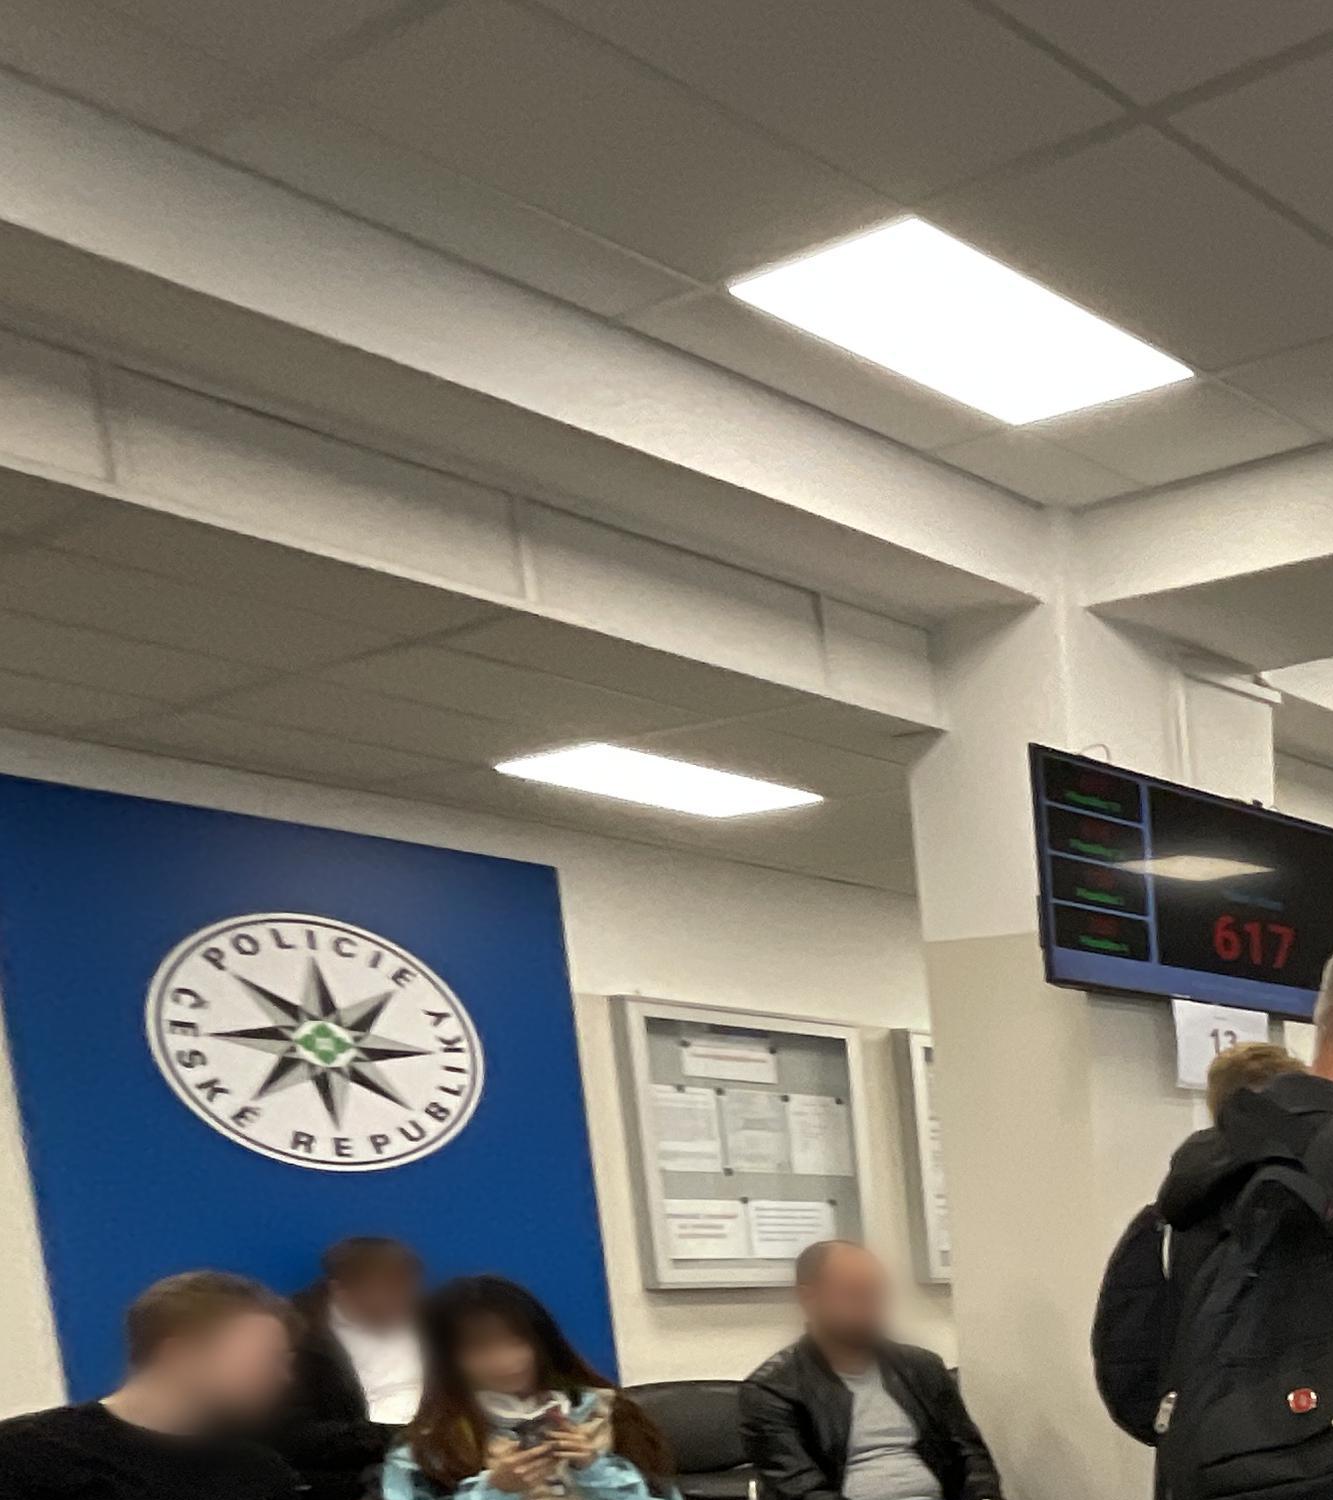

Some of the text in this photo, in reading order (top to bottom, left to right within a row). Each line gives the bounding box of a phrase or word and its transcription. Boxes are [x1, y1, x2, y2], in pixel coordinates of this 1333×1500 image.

[202, 928, 418, 989] POLICIE
[1213, 914, 1296, 969] 617
[290, 1008, 468, 1157] REPUBLIKY
